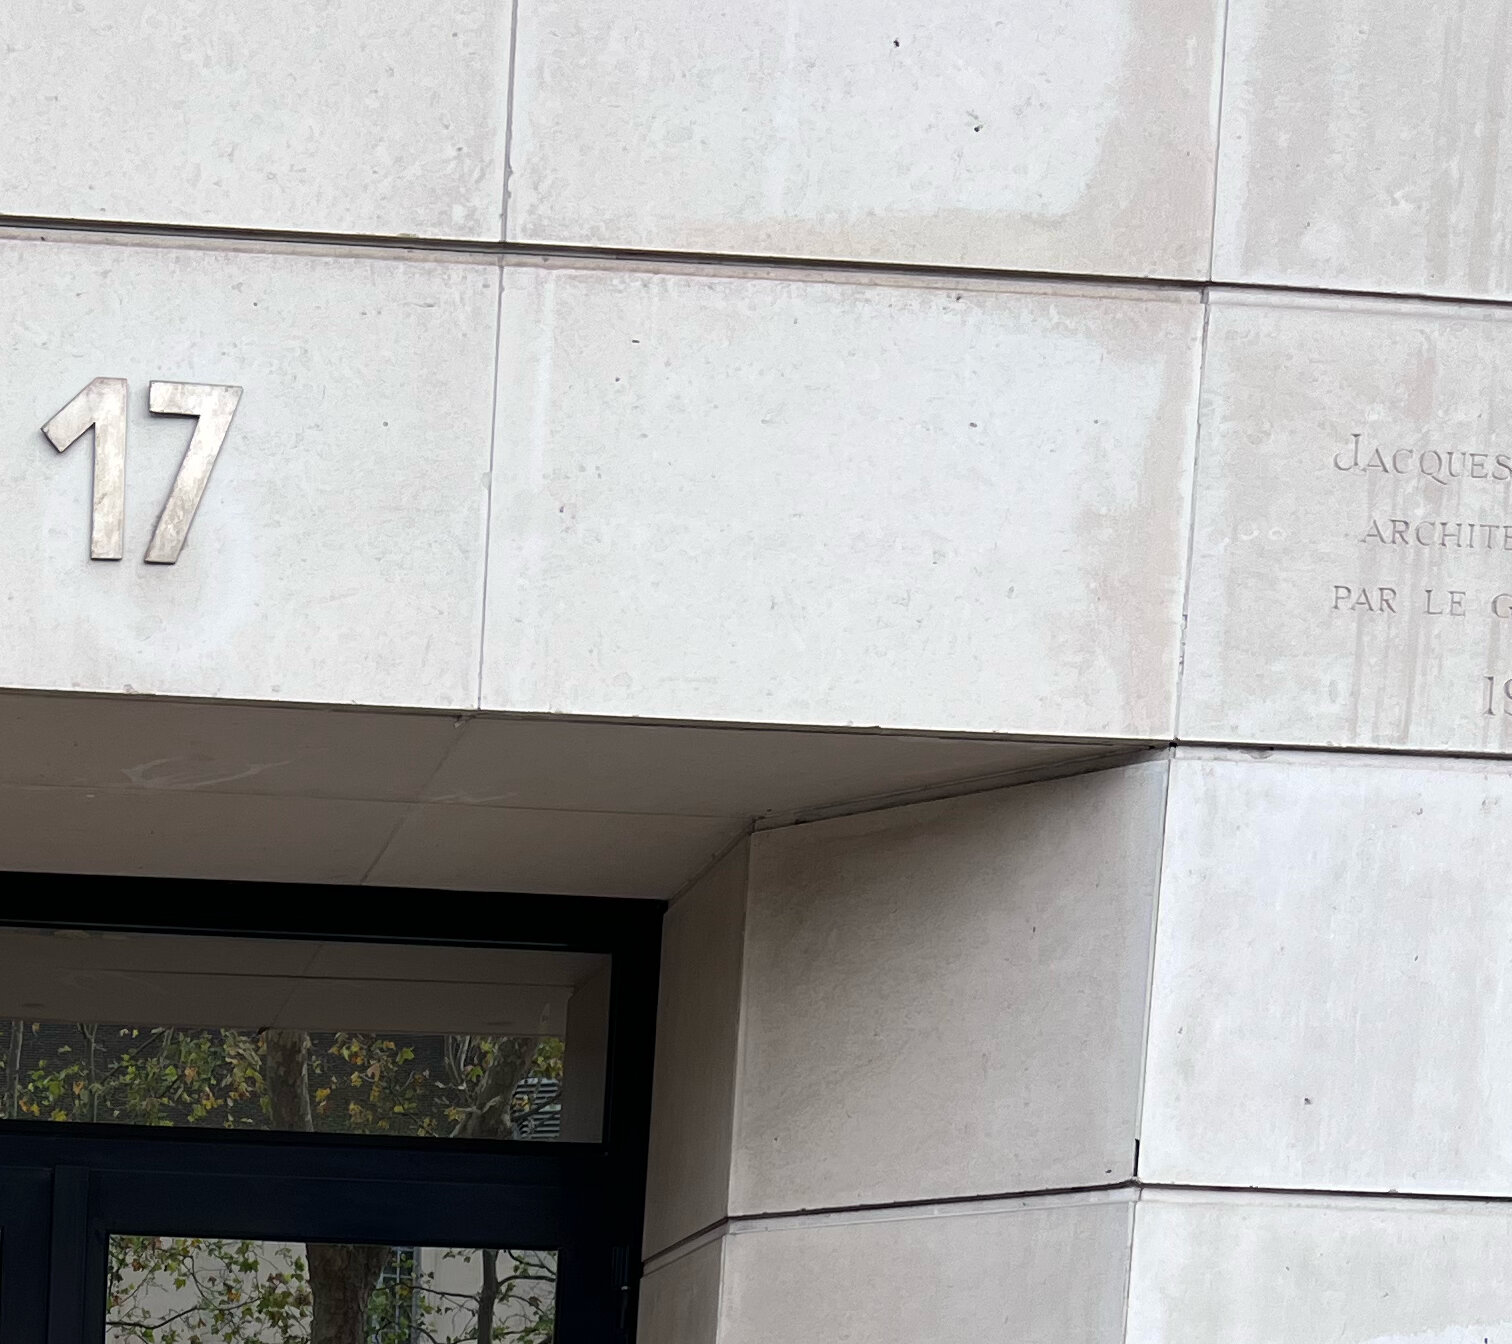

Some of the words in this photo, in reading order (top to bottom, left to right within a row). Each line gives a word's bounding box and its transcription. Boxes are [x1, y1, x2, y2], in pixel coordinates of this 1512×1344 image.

[40, 377, 243, 565] 17
[1333, 433, 1512, 485] JACQUES
[1333, 585, 1397, 614] PAR
[1423, 589, 1466, 616] LE
